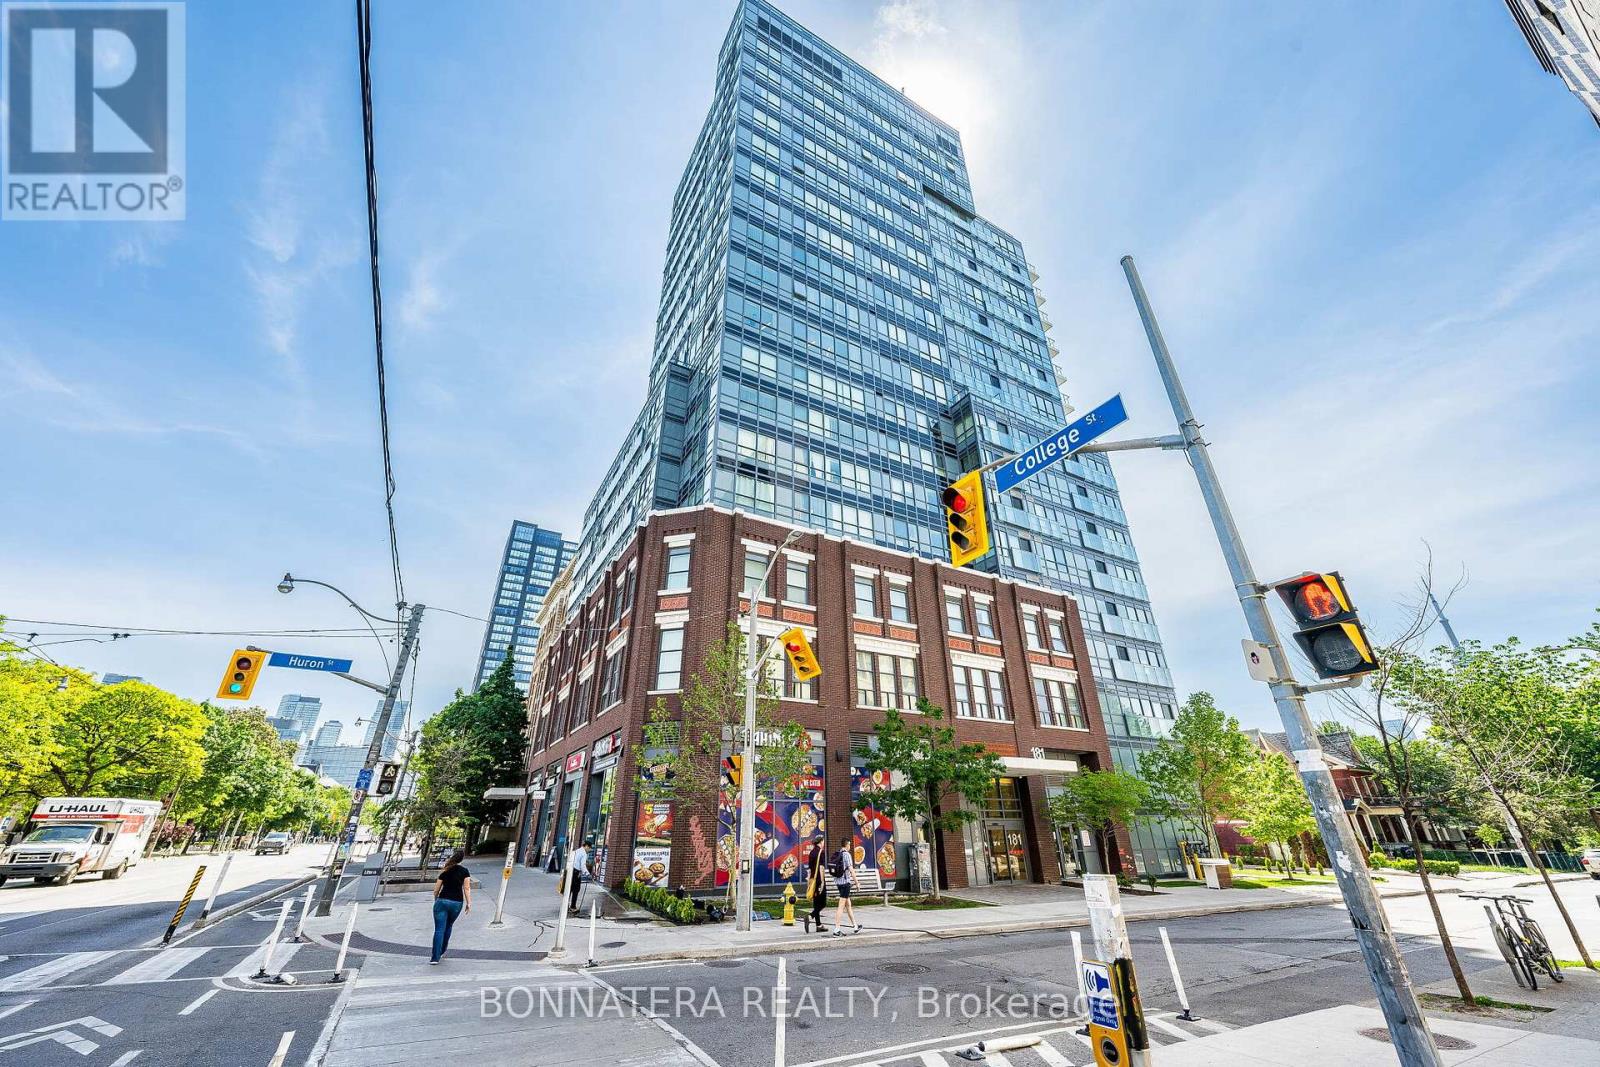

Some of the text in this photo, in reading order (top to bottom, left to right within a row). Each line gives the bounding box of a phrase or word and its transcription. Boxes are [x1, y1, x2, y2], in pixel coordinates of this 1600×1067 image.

[1014, 413, 1097, 475] College St
[288, 656, 324, 669] Huron
[1031, 746, 1045, 760] 181
[48, 804, 109, 813] U-HAUL
[1007, 833, 1022, 846] 181
